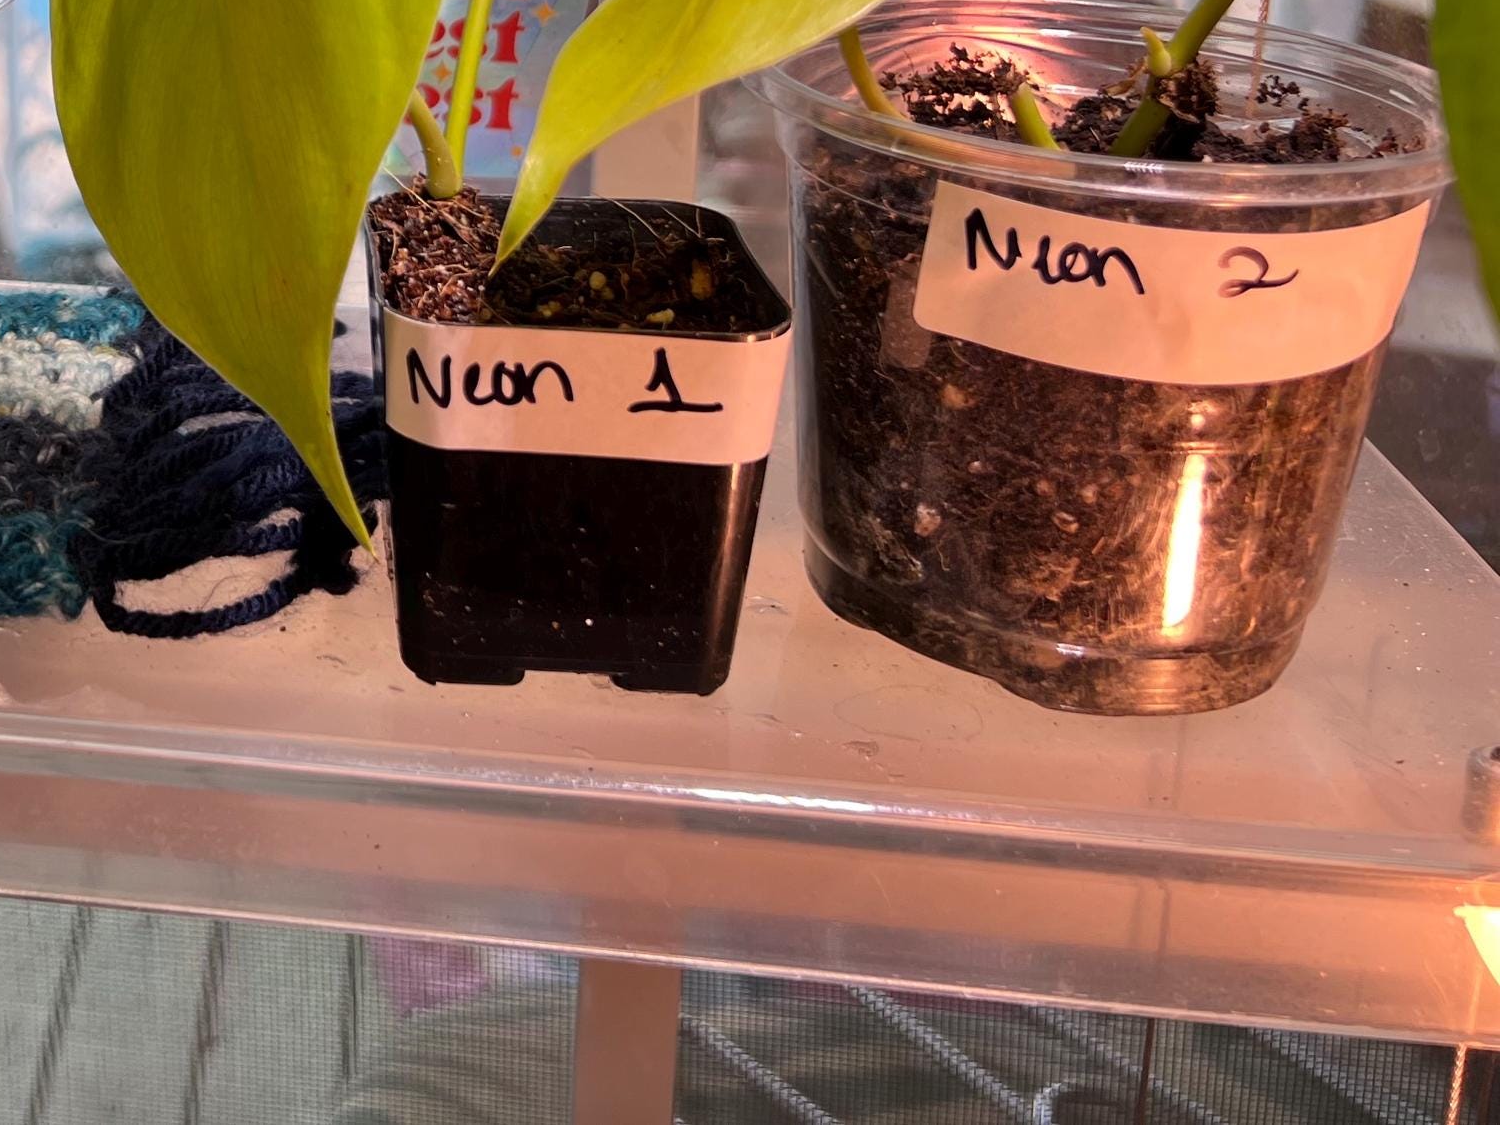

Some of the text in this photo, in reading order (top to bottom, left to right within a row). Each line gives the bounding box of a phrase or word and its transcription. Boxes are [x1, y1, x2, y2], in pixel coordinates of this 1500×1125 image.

[1217, 245, 1300, 299] 2
[405, 346, 724, 414] Neon 1
